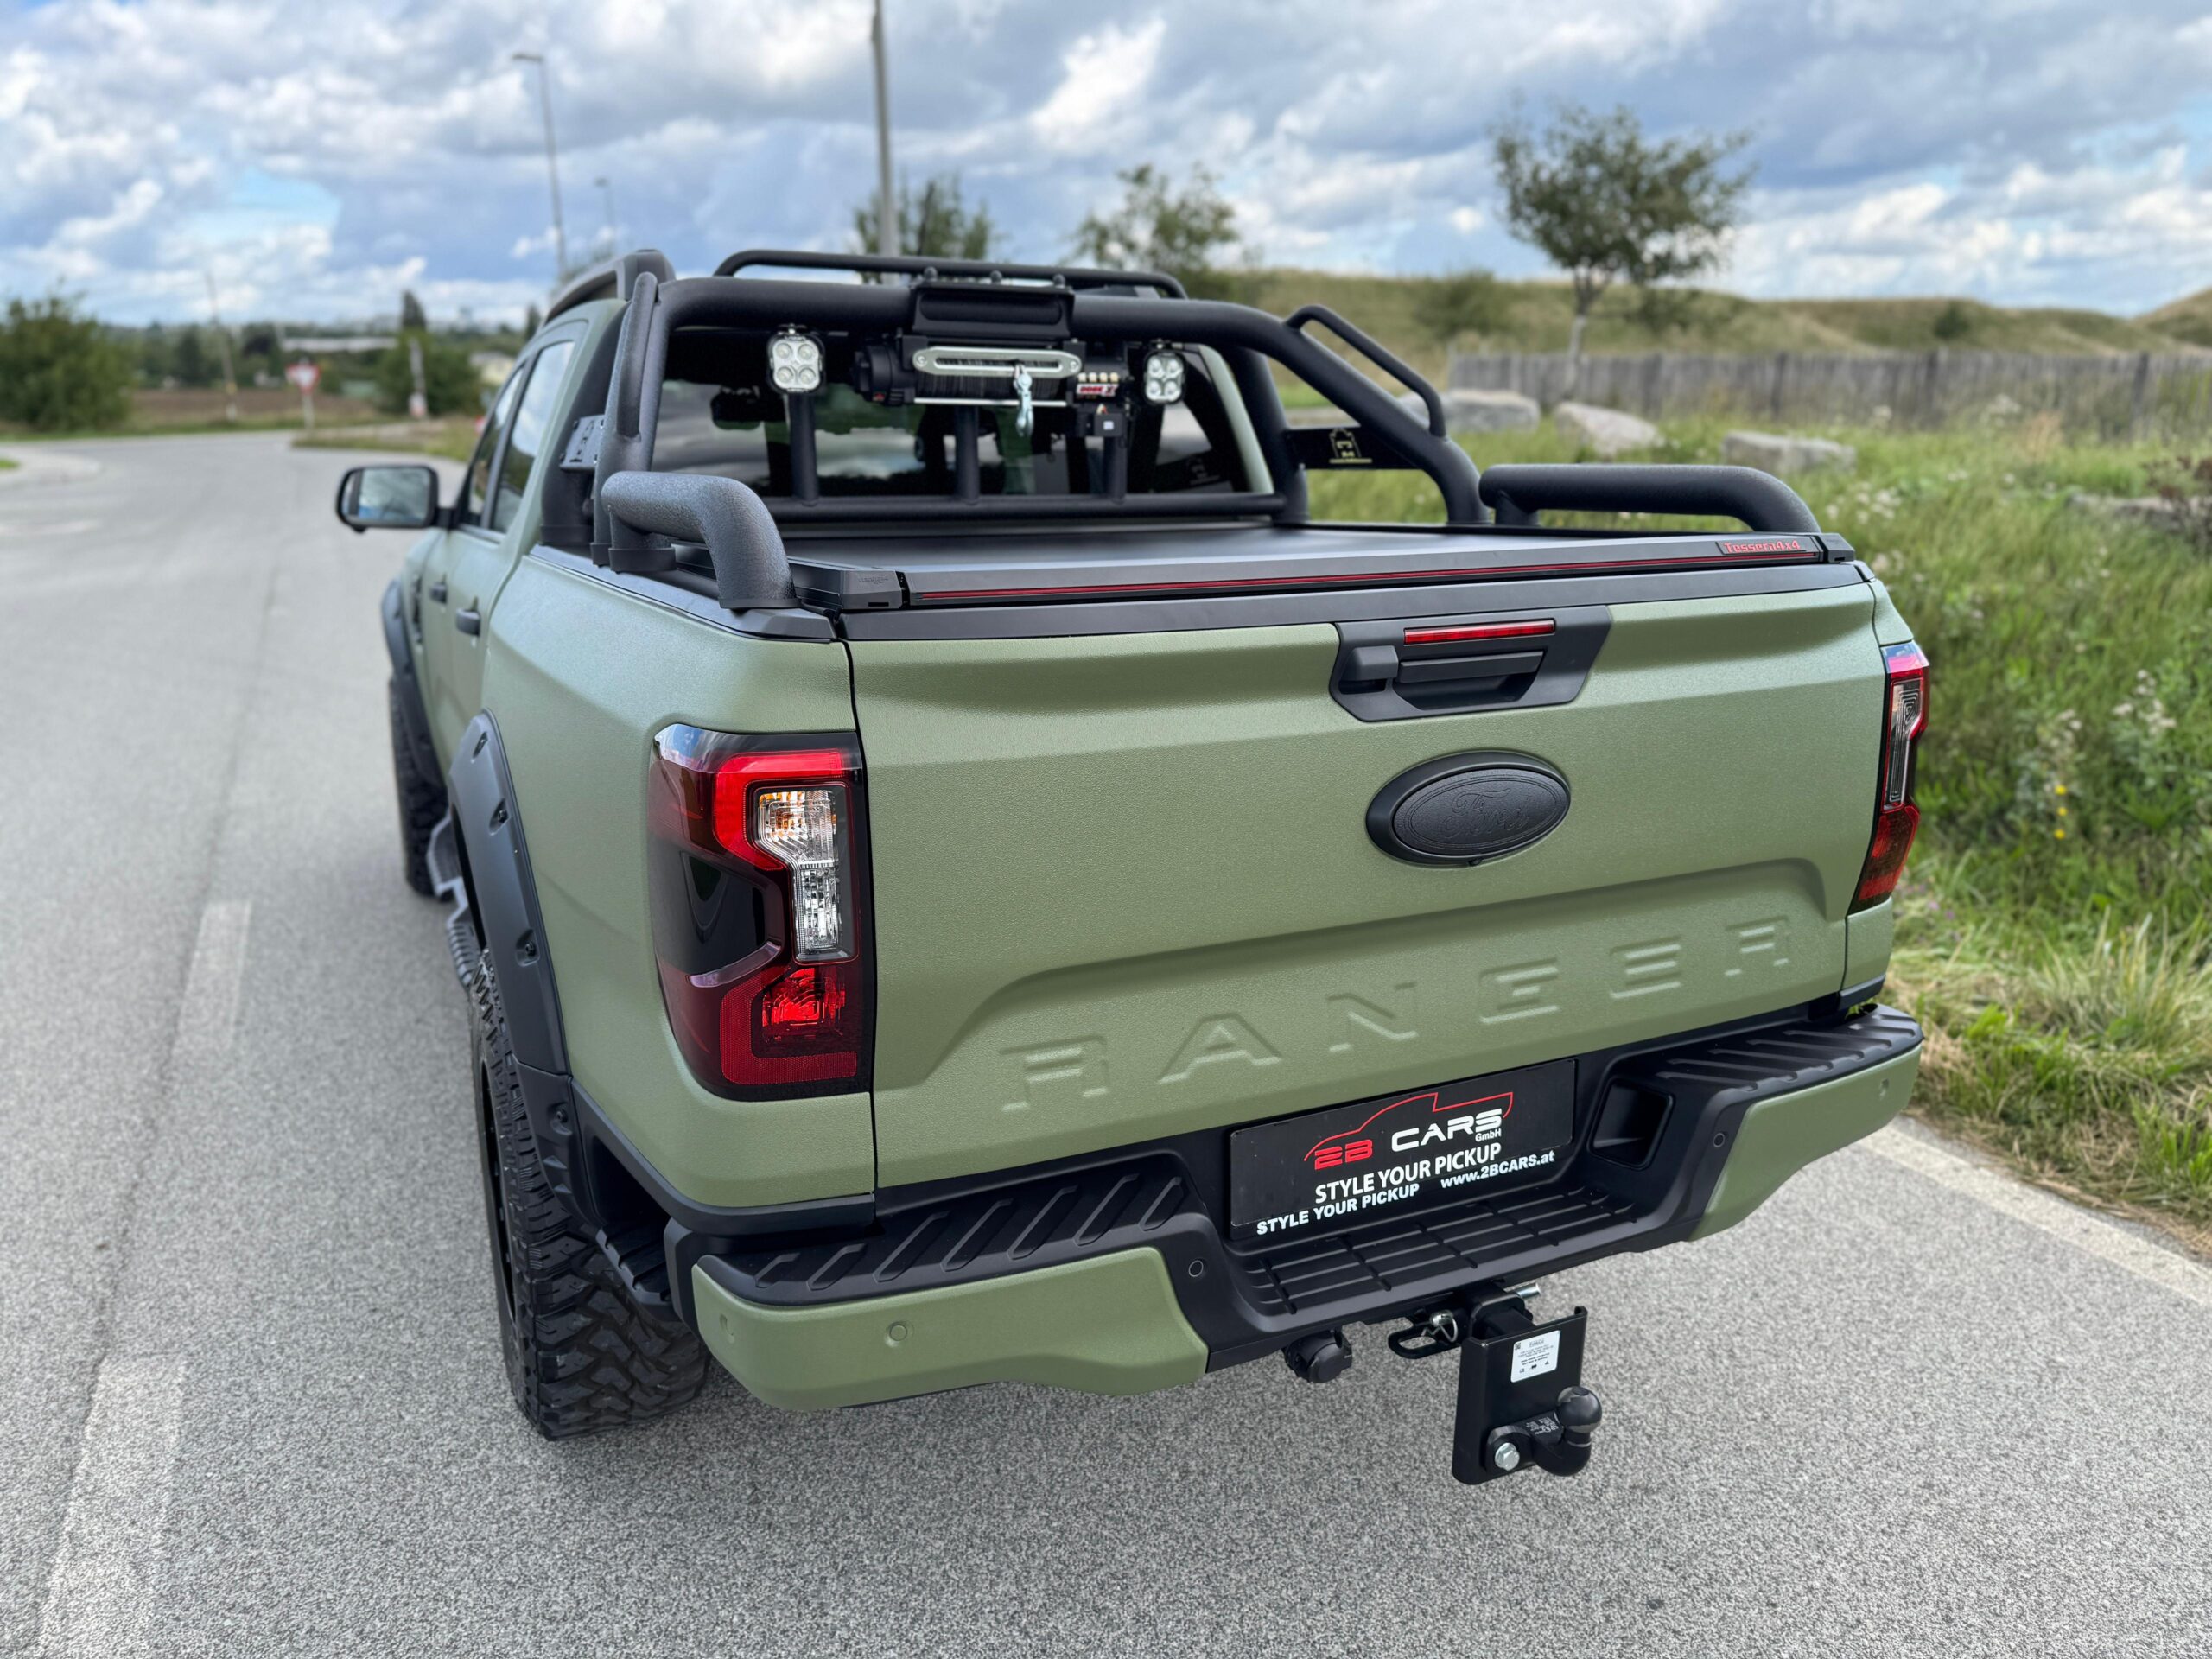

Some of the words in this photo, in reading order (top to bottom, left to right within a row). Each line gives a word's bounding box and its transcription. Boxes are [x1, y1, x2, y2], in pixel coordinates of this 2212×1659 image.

[1725, 540, 1800, 553] Tessera4x4
[1000, 916, 1790, 1111] RANGER
[1314, 1139, 1373, 1171] 2B
[1391, 1108, 1503, 1152] CARS
[1475, 1128, 1502, 1142] GmbH
[1315, 1173, 1375, 1204] STYLE
[1377, 1160, 1431, 1186] YOUR
[1435, 1142, 1502, 1173] PICKUP
[1440, 1150, 1555, 1189] www.2BCARS.at
[1256, 1211, 1309, 1236] STYLE
[1313, 1198, 1357, 1220] YOUR
[1362, 1183, 1420, 1208] PICKUP
